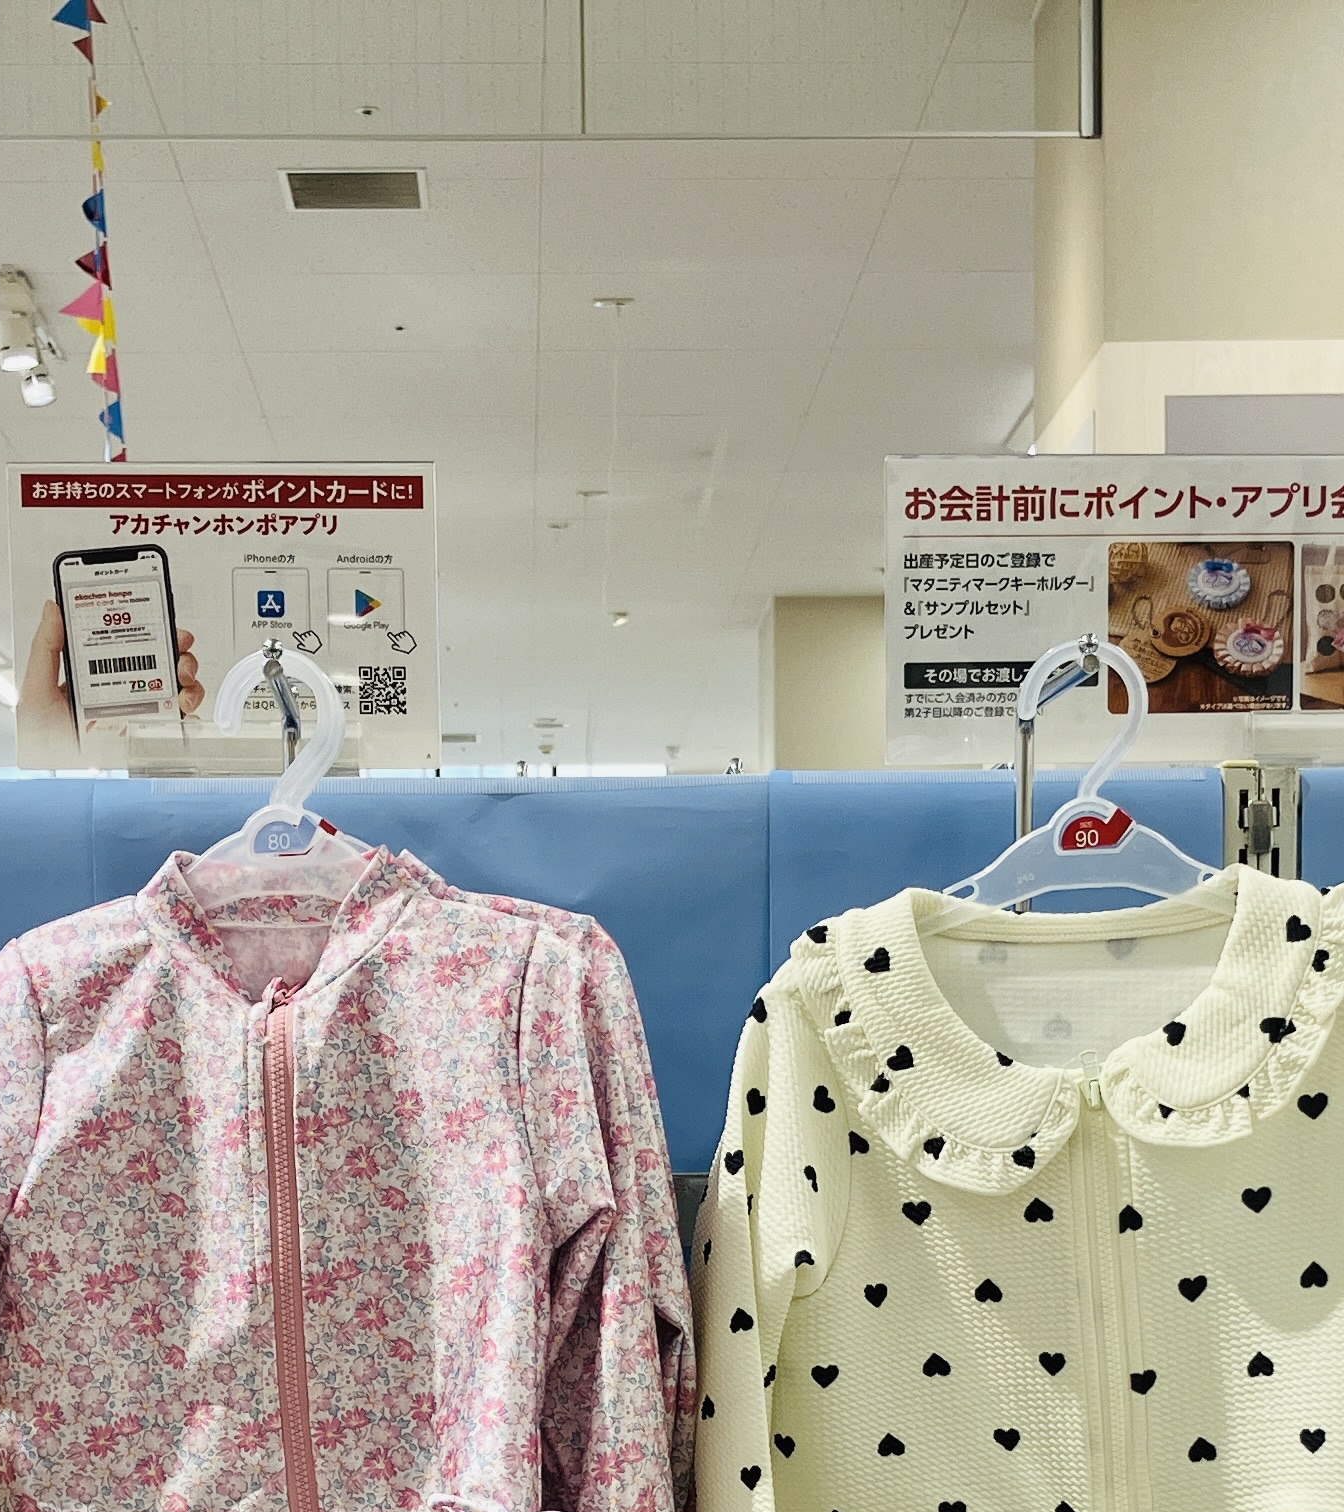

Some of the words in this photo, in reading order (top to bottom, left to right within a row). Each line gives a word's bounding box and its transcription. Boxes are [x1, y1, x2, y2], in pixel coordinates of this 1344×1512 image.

[109, 513, 338, 536] アカチャンホンポアプリ
[243, 554, 296, 564] iPhoneの方
[336, 554, 393, 564] Androidの方
[903, 552, 1056, 570] 出産予定日のご登録で
[102, 612, 132, 626] 999
[270, 621, 293, 629] Store
[373, 621, 389, 631] Play
[903, 623, 975, 640] プレゼント
[923, 666, 1066, 684] その場でお渡し
[267, 833, 291, 850] 80
[1075, 829, 1099, 848] 90
